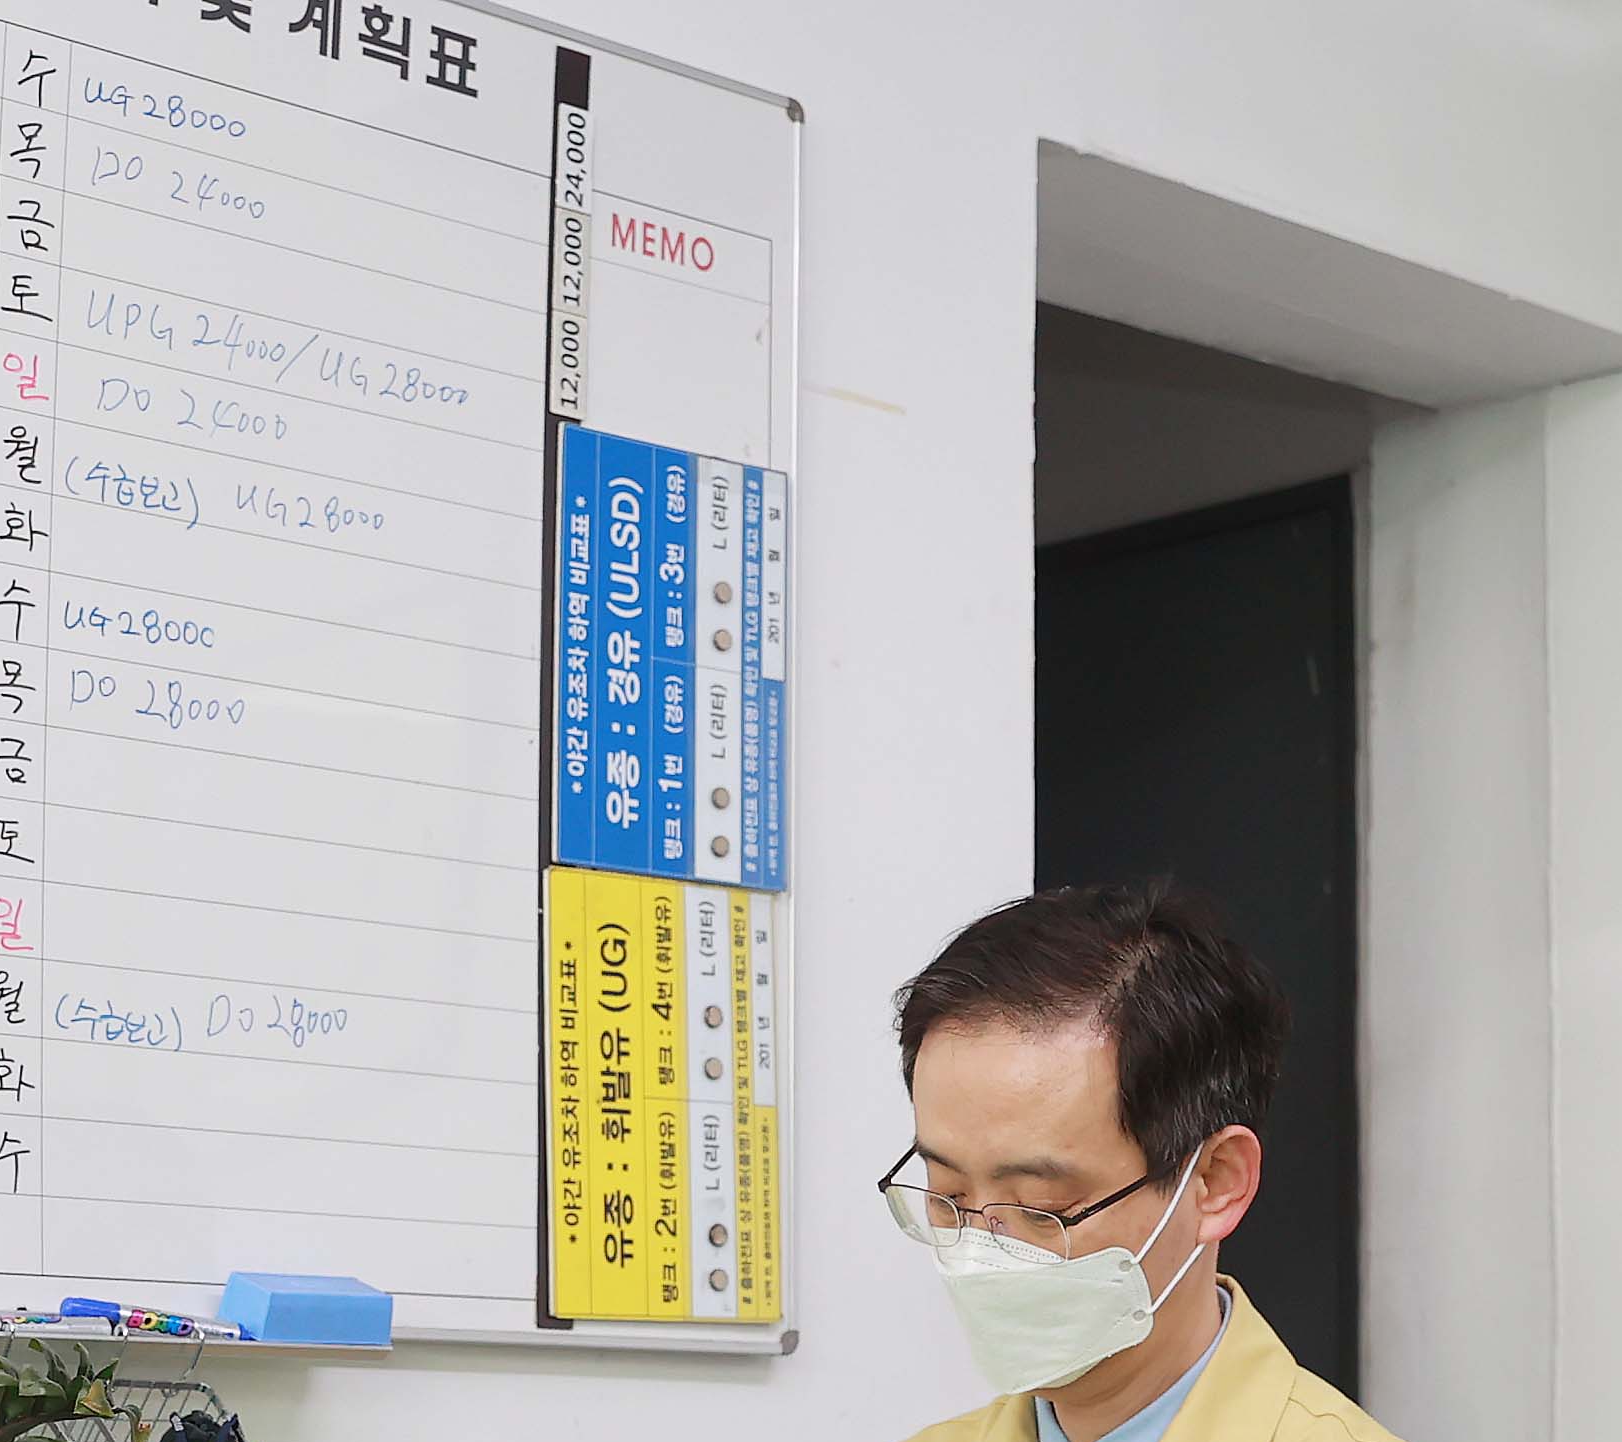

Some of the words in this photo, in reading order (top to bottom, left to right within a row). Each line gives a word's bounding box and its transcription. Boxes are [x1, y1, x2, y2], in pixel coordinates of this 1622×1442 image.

[17, 49, 58, 108] 수
[286, 0, 479, 99] 계획표
[84, 77, 133, 118] UG
[143, 94, 246, 138] 28000
[9, 121, 47, 179] 목
[565, 112, 587, 207] 24,000
[170, 171, 266, 220] 24000
[6, 200, 55, 252] 금
[611, 213, 715, 272] MEMO
[564, 217, 583, 307] 12,000
[0, 275, 53, 322] 토
[3, 353, 49, 402] 일
[562, 320, 580, 409] 12,000
[98, 377, 151, 413] DO
[4, 425, 41, 485] 월
[298, 497, 384, 534] 28000
[665, 465, 687, 523] (경유)
[710, 474, 730, 531] (리터)
[568, 513, 590, 586] 비교표
[606, 476, 644, 619] (ULSD)
[659, 543, 685, 585] 3번
[712, 538, 728, 550] L
[64, 600, 112, 635] UG
[567, 593, 589, 641] 하역
[664, 605, 683, 647] 탱크
[565, 649, 589, 722] 유조차
[607, 629, 642, 706] 경유
[70, 668, 116, 710] DO
[135, 679, 245, 730] 28000
[663, 674, 685, 734] (경유)
[709, 683, 728, 741] (리터)
[567, 727, 589, 777] 야간
[657, 753, 683, 793] 1번
[710, 746, 726, 759] L
[605, 750, 641, 829] 유종
[663, 817, 683, 859] 탱크
[654, 896, 674, 973] (휘발유)
[698, 900, 718, 958] (리터)
[558, 957, 578, 1030] 비교표
[597, 923, 629, 1013] (UG)
[701, 963, 716, 977] L
[651, 981, 674, 1021] 4번
[559, 1038, 580, 1087] 하역
[599, 1027, 632, 1144] 휘발유
[656, 1044, 675, 1085] 탱크
[560, 1096, 582, 1170] 유조차
[658, 1112, 678, 1189] (휘발유)
[703, 1114, 722, 1172] (리터)
[562, 1178, 583, 1226] 야간
[705, 1178, 721, 1191] L
[601, 1189, 635, 1269] 유종
[654, 1197, 678, 1237] 2번
[660, 1261, 678, 1303] 탱크
